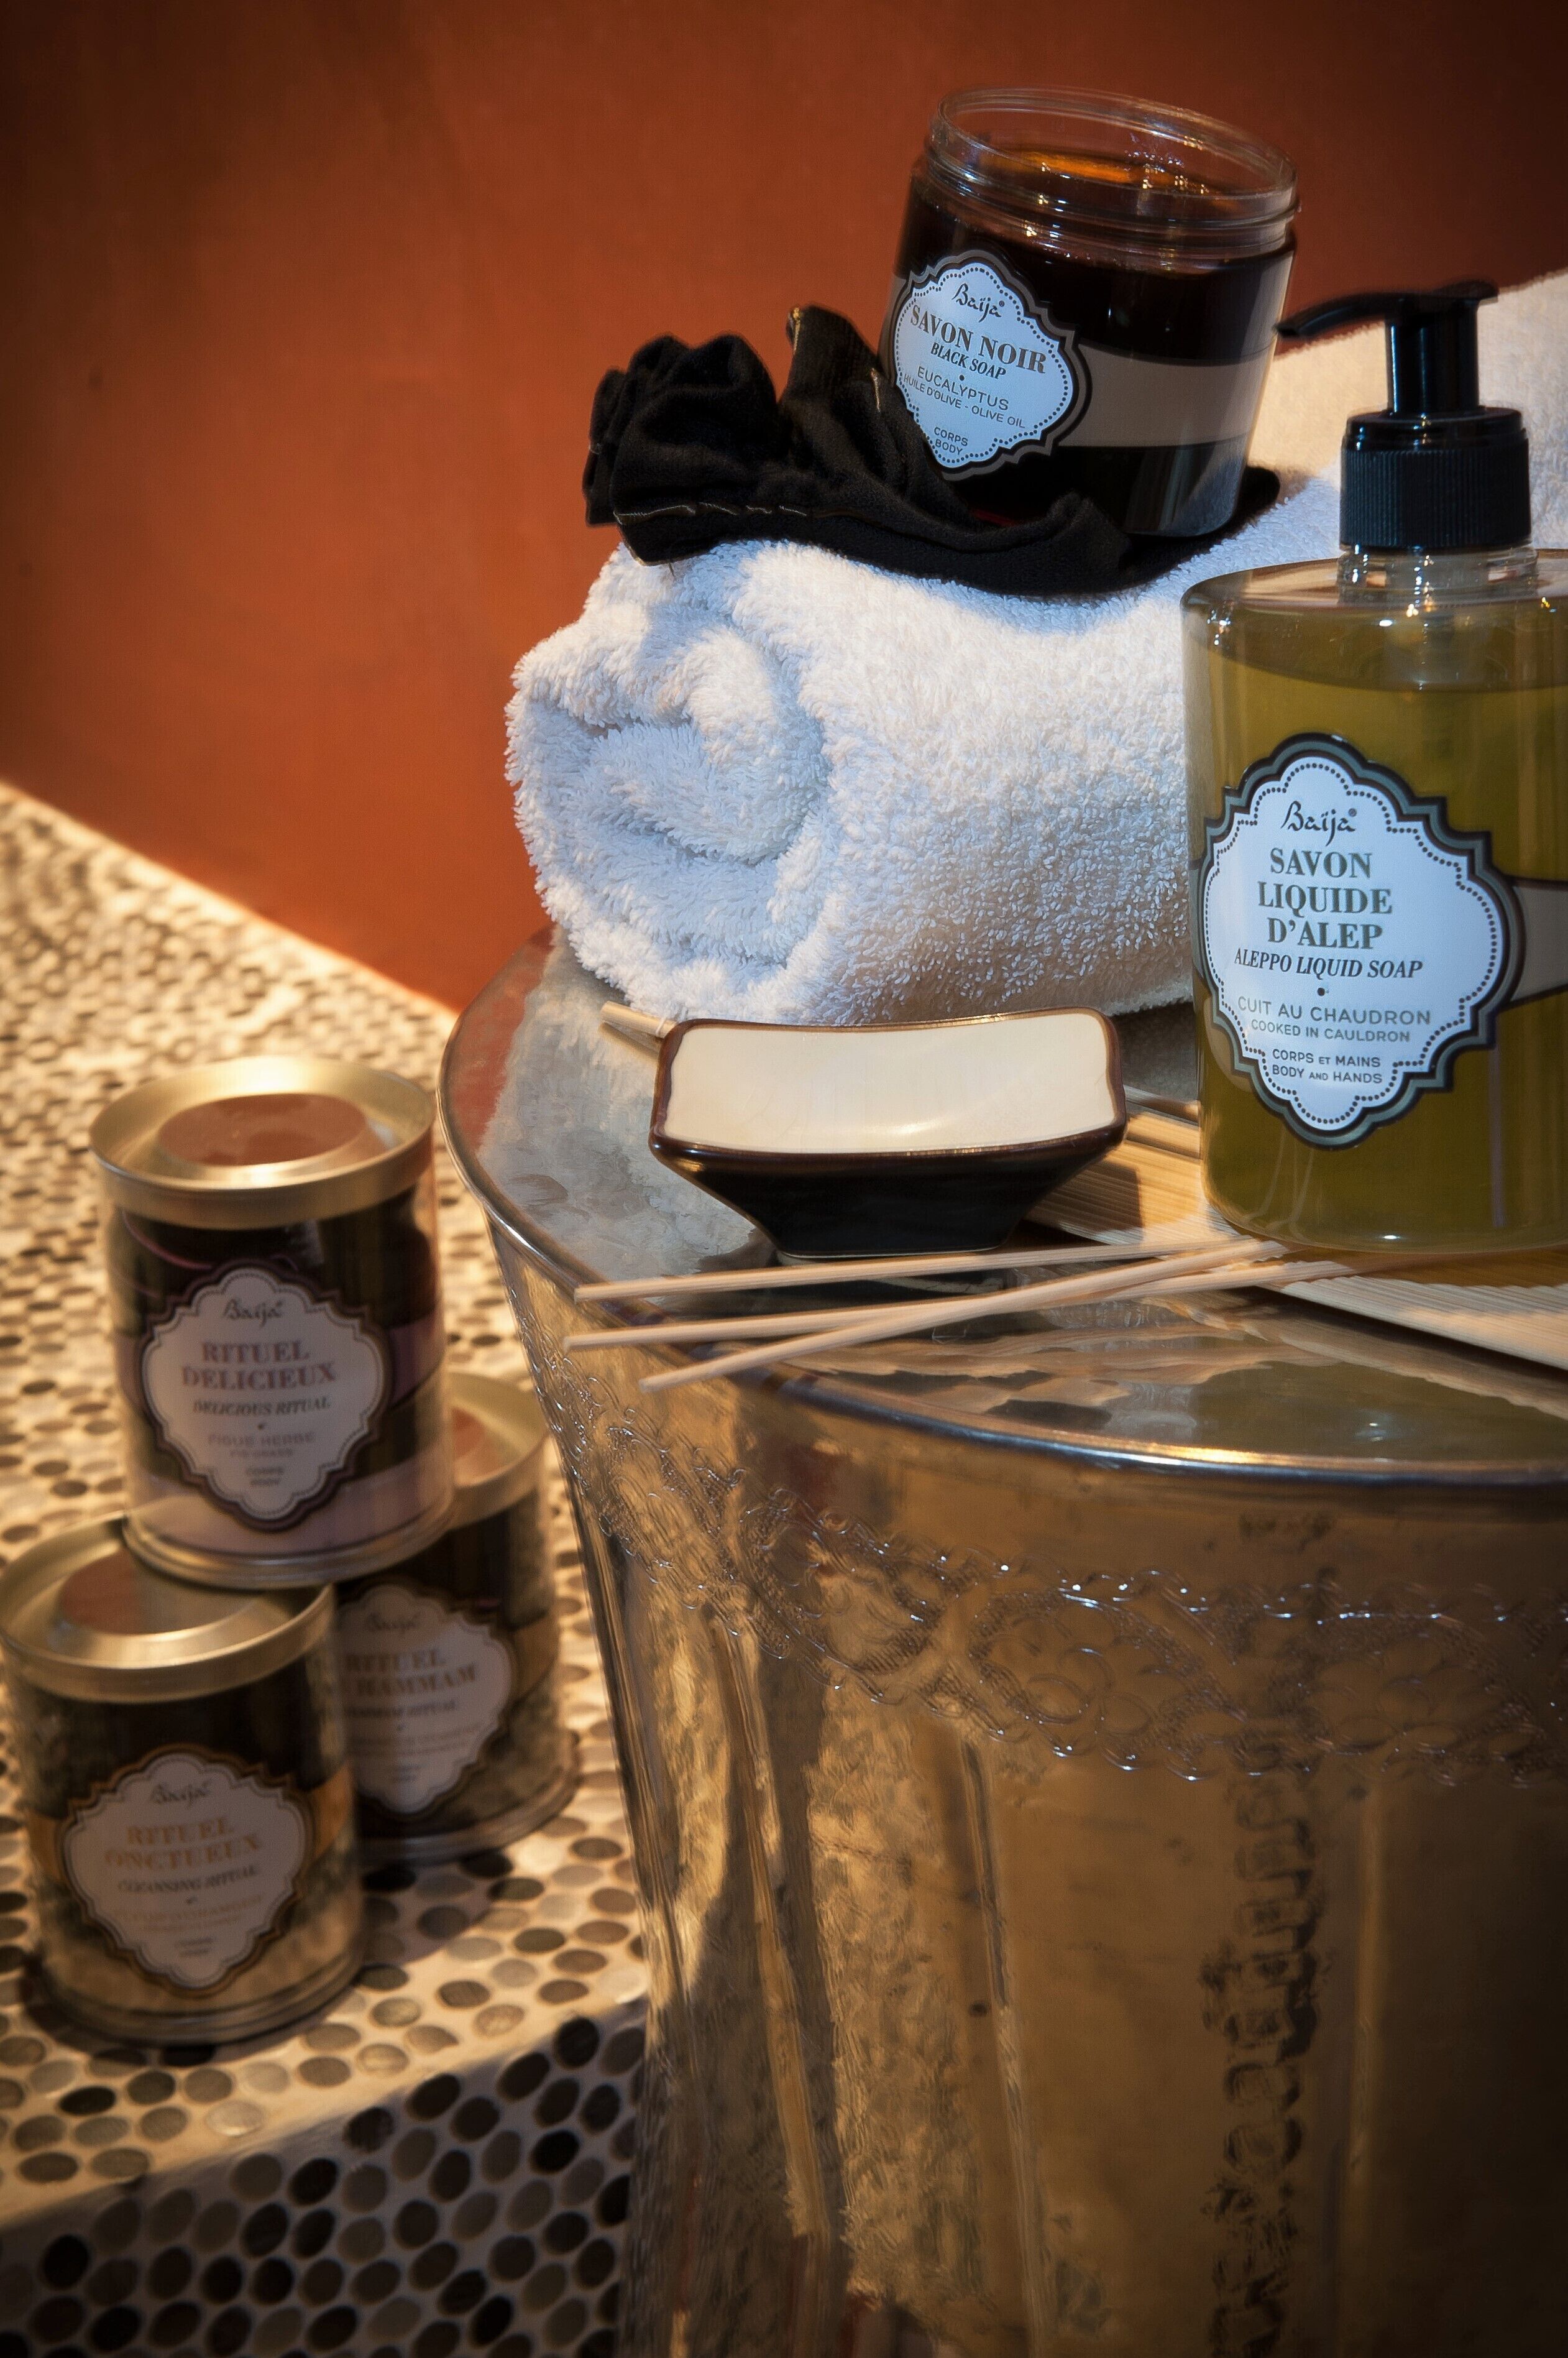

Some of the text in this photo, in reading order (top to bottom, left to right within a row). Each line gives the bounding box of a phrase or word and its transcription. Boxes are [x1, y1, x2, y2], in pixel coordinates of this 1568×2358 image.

[910, 305, 1047, 374] SAVON NOIR
[930, 343, 1007, 380] BLACK SOAP
[903, 374, 925, 393] HUILE
[927, 387, 962, 408] D'OLIVE
[971, 405, 1004, 423] OLIVE
[1007, 416, 1026, 428] OIL
[917, 366, 1009, 411] EUCALYPTUS
[933, 426, 969, 447] CORPS
[935, 439, 963, 456] BODY
[1270, 847, 1372, 878] SAVON
[1257, 881, 1393, 918] LIQUIDE
[1267, 917, 1383, 950] D'ALEP
[1234, 947, 1423, 980] ALEPPO LIQUID SOAP
[1237, 996, 1431, 1025] CUIT AU CHAUDRON
[1251, 1018, 1411, 1043] COOKED IN CAULDRON
[1272, 1048, 1314, 1064] CORPS
[1336, 1055, 1381, 1068] MAINS
[1272, 1064, 1382, 1084] BODY AND HANDS
[201, 1340, 310, 1364] RITUEL
